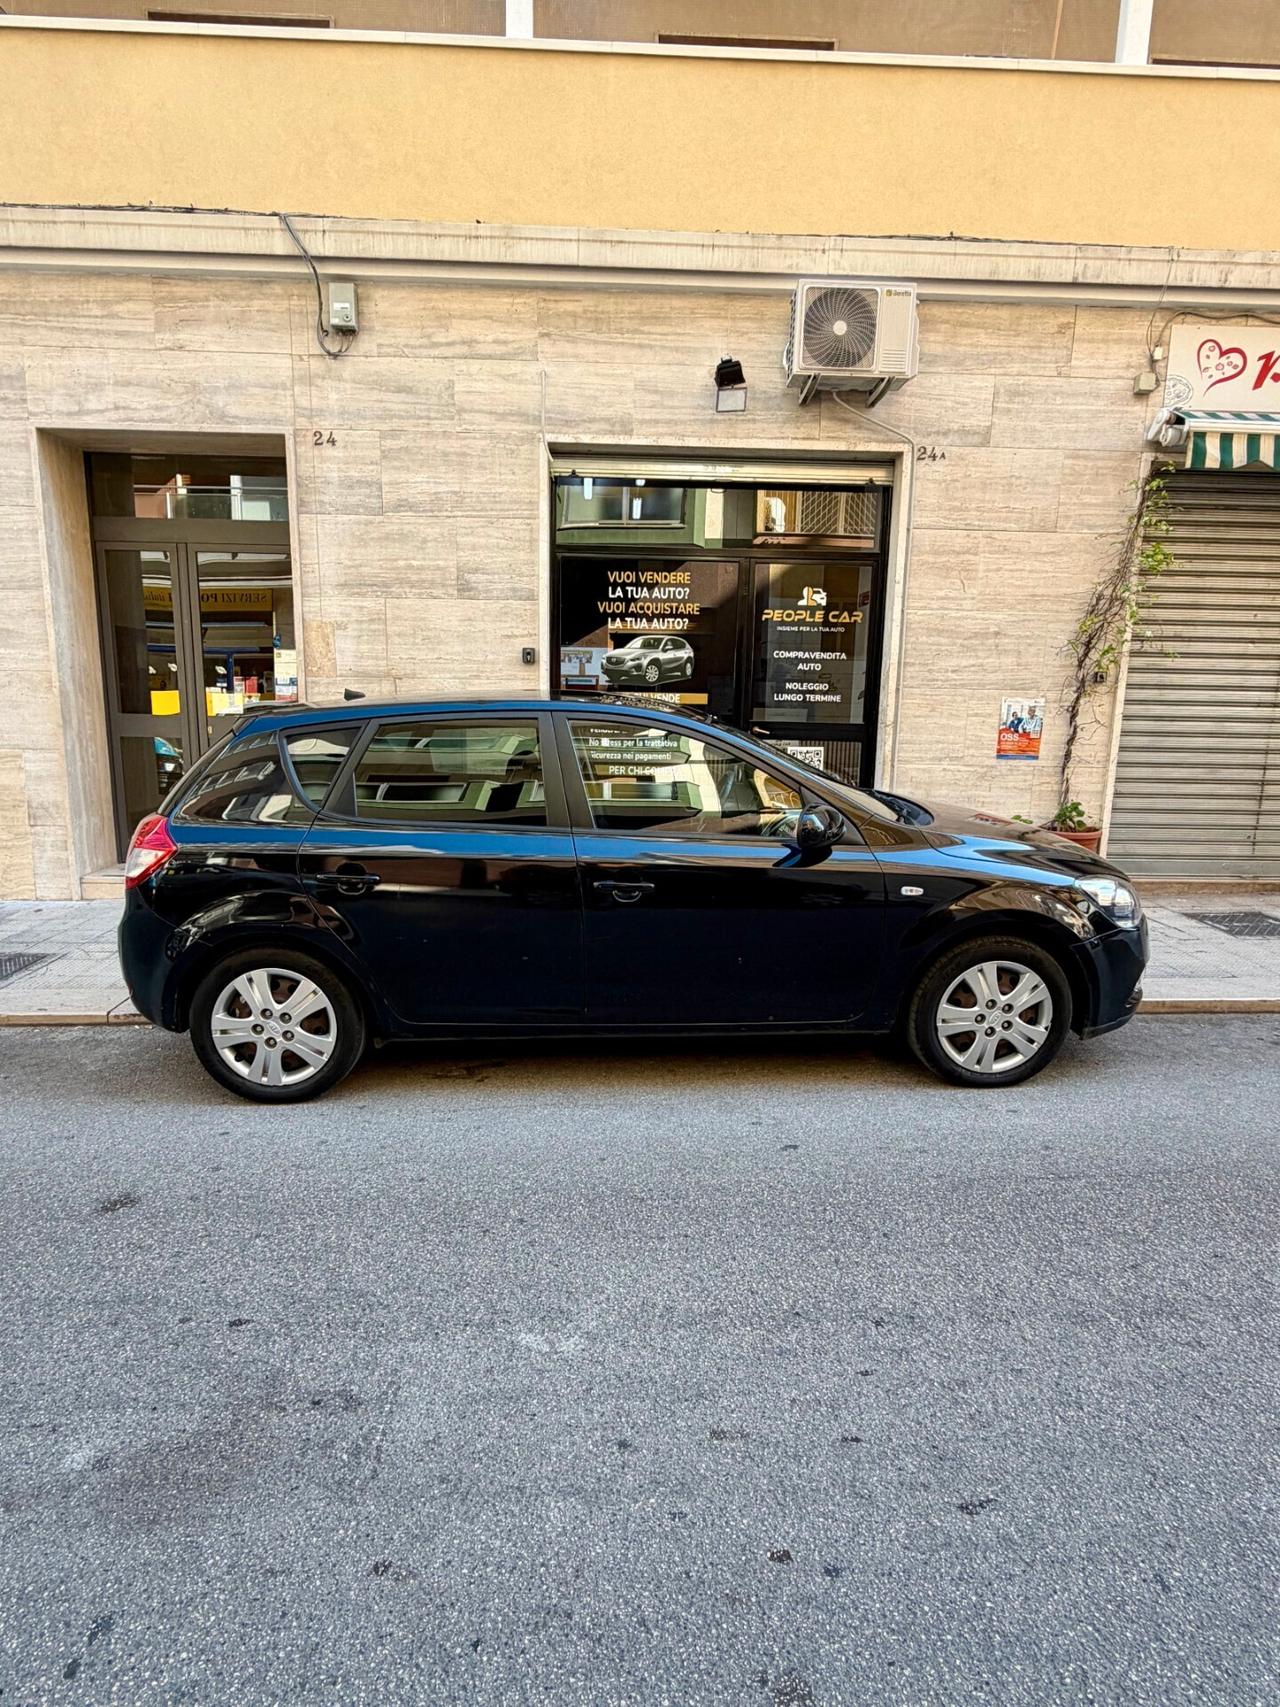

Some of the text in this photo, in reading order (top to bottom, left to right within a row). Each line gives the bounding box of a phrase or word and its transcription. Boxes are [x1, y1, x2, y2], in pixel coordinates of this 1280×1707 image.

[313, 430, 337, 446] 24
[608, 571, 691, 584] VUOI VENDERE
[608, 586, 690, 600] LA TUA AUTO?
[597, 601, 700, 616] VUOI ACQUISTARE
[762, 609, 864, 623] PEOPLE CAR
[608, 617, 689, 630] LA TUA AUTO?
[773, 650, 847, 660] COMPRAVENDITA
[797, 663, 821, 671] AUTO
[786, 682, 829, 691] NOLEGGIO
[774, 693, 842, 702] LUNGO TERMINE
[589, 737, 678, 748] No ess per la trattativa
[623, 751, 634, 760] nei
[635, 752, 672, 761] pagamenti
[608, 765, 626, 775] PER
[628, 765, 643, 775] CHI
